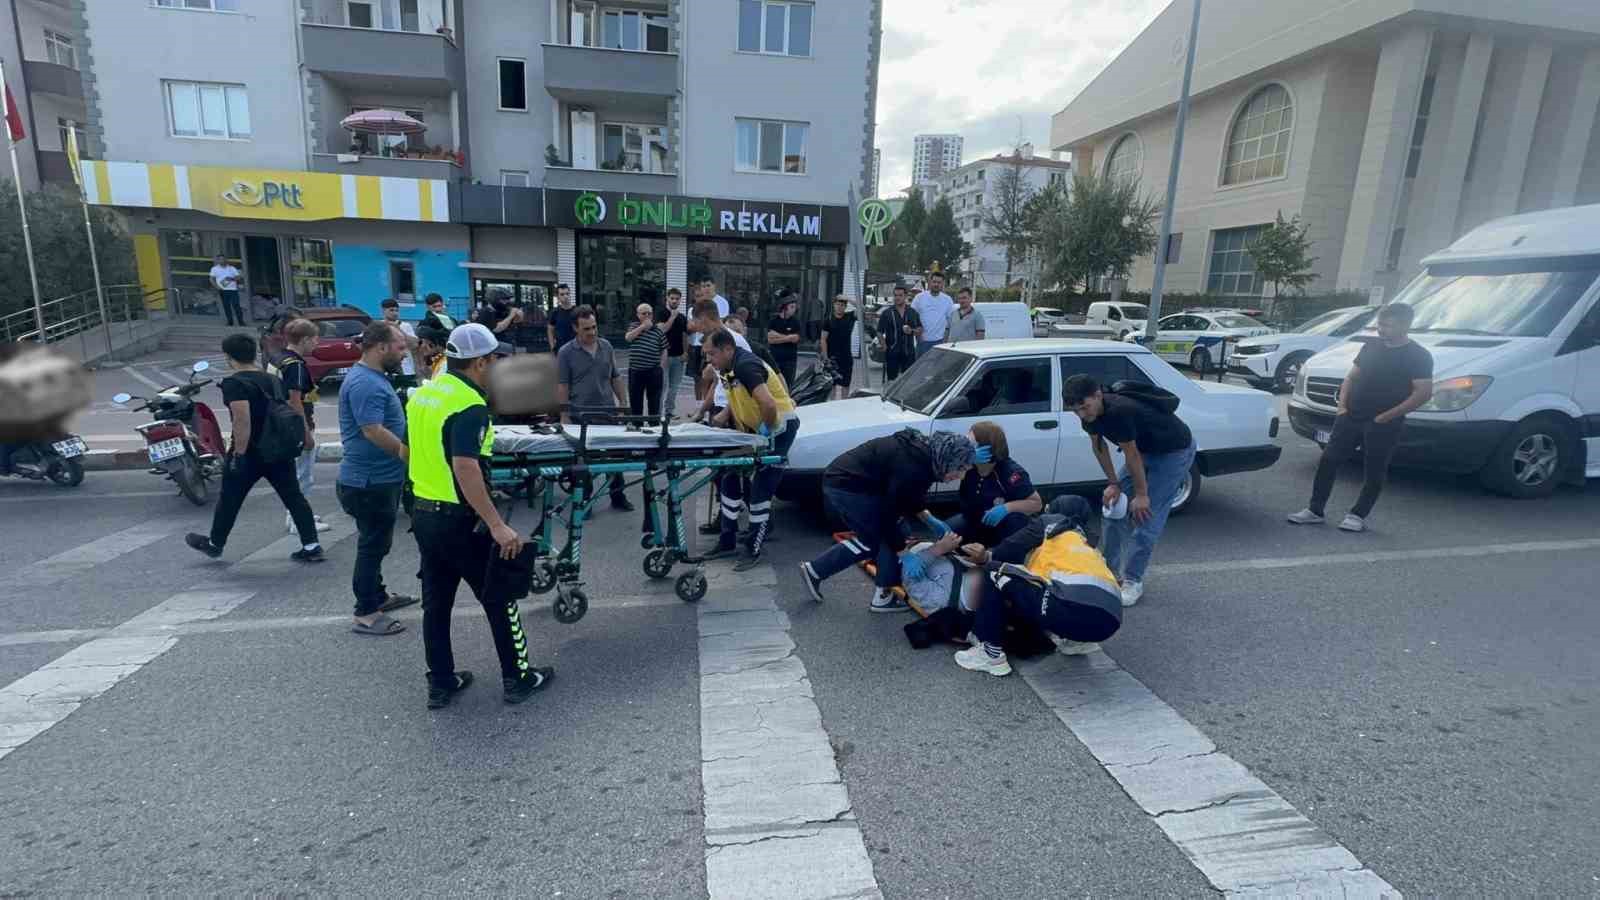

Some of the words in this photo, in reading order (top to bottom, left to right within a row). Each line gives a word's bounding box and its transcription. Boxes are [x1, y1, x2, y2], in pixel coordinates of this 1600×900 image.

[263, 181, 304, 208] Ptt
[617, 199, 712, 228] ONUR
[720, 210, 820, 236] REKLAM
